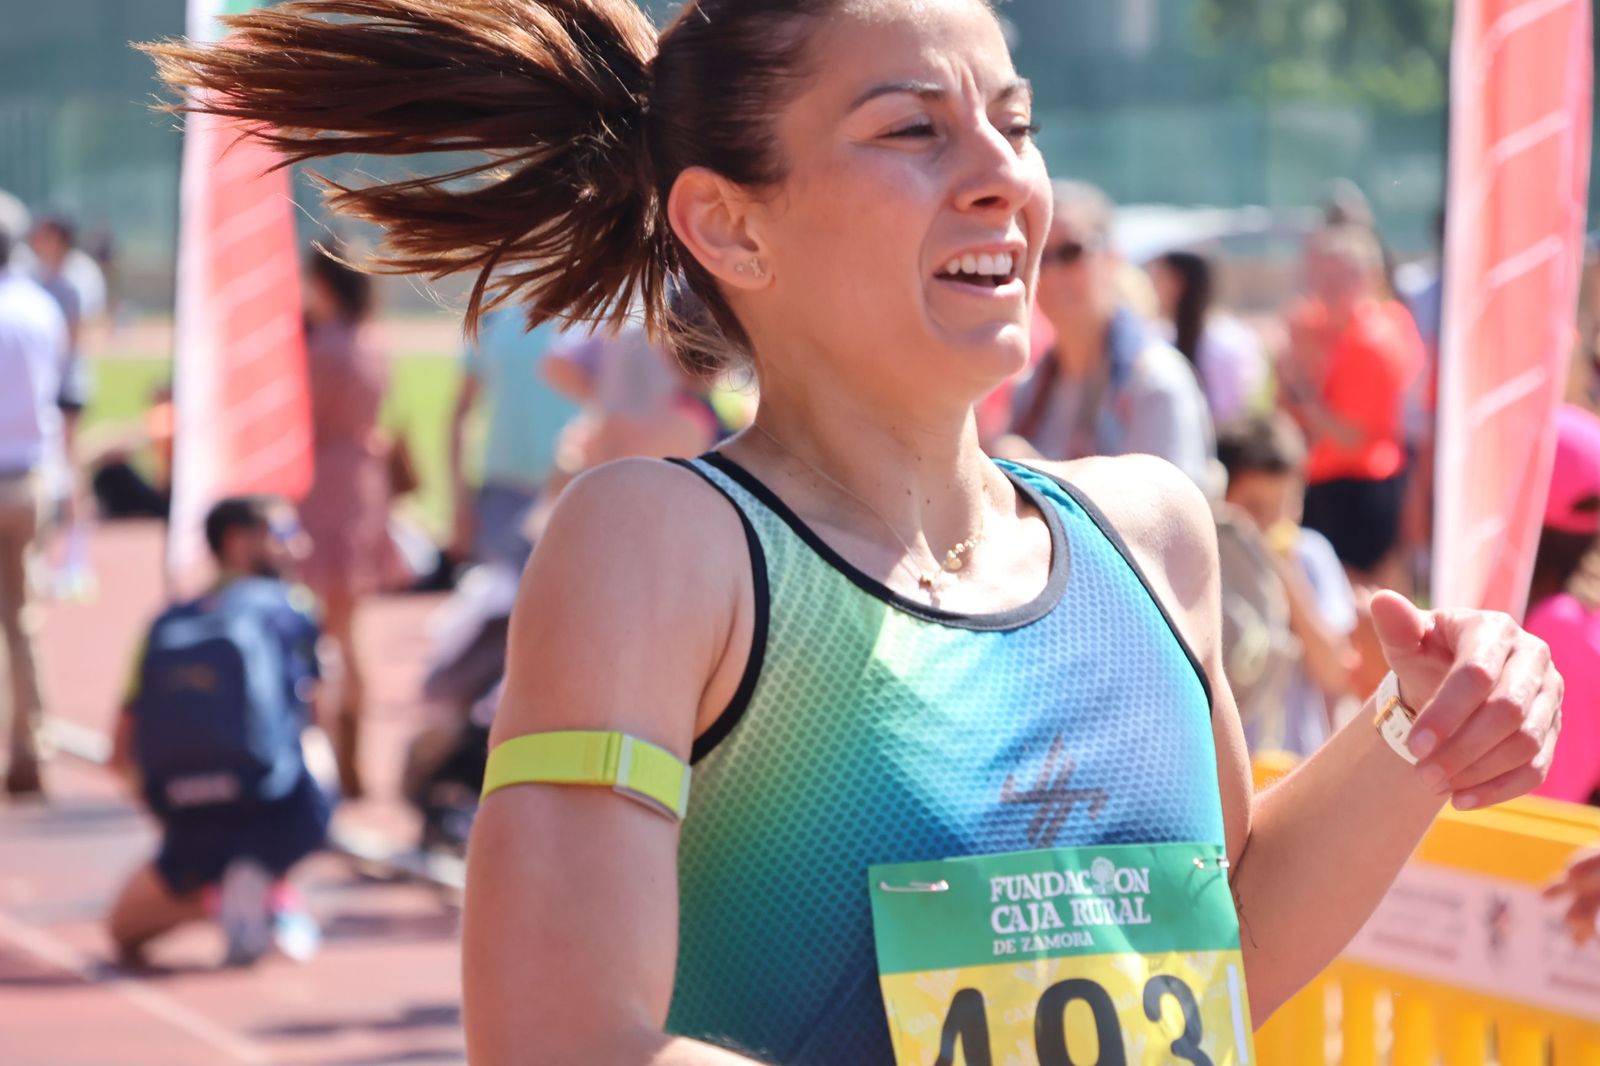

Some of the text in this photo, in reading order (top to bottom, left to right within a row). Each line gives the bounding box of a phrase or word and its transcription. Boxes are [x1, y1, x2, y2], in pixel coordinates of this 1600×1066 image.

[991, 897, 1152, 934] CAJA RURAL
[993, 931, 1094, 955] DE ZAMORA
